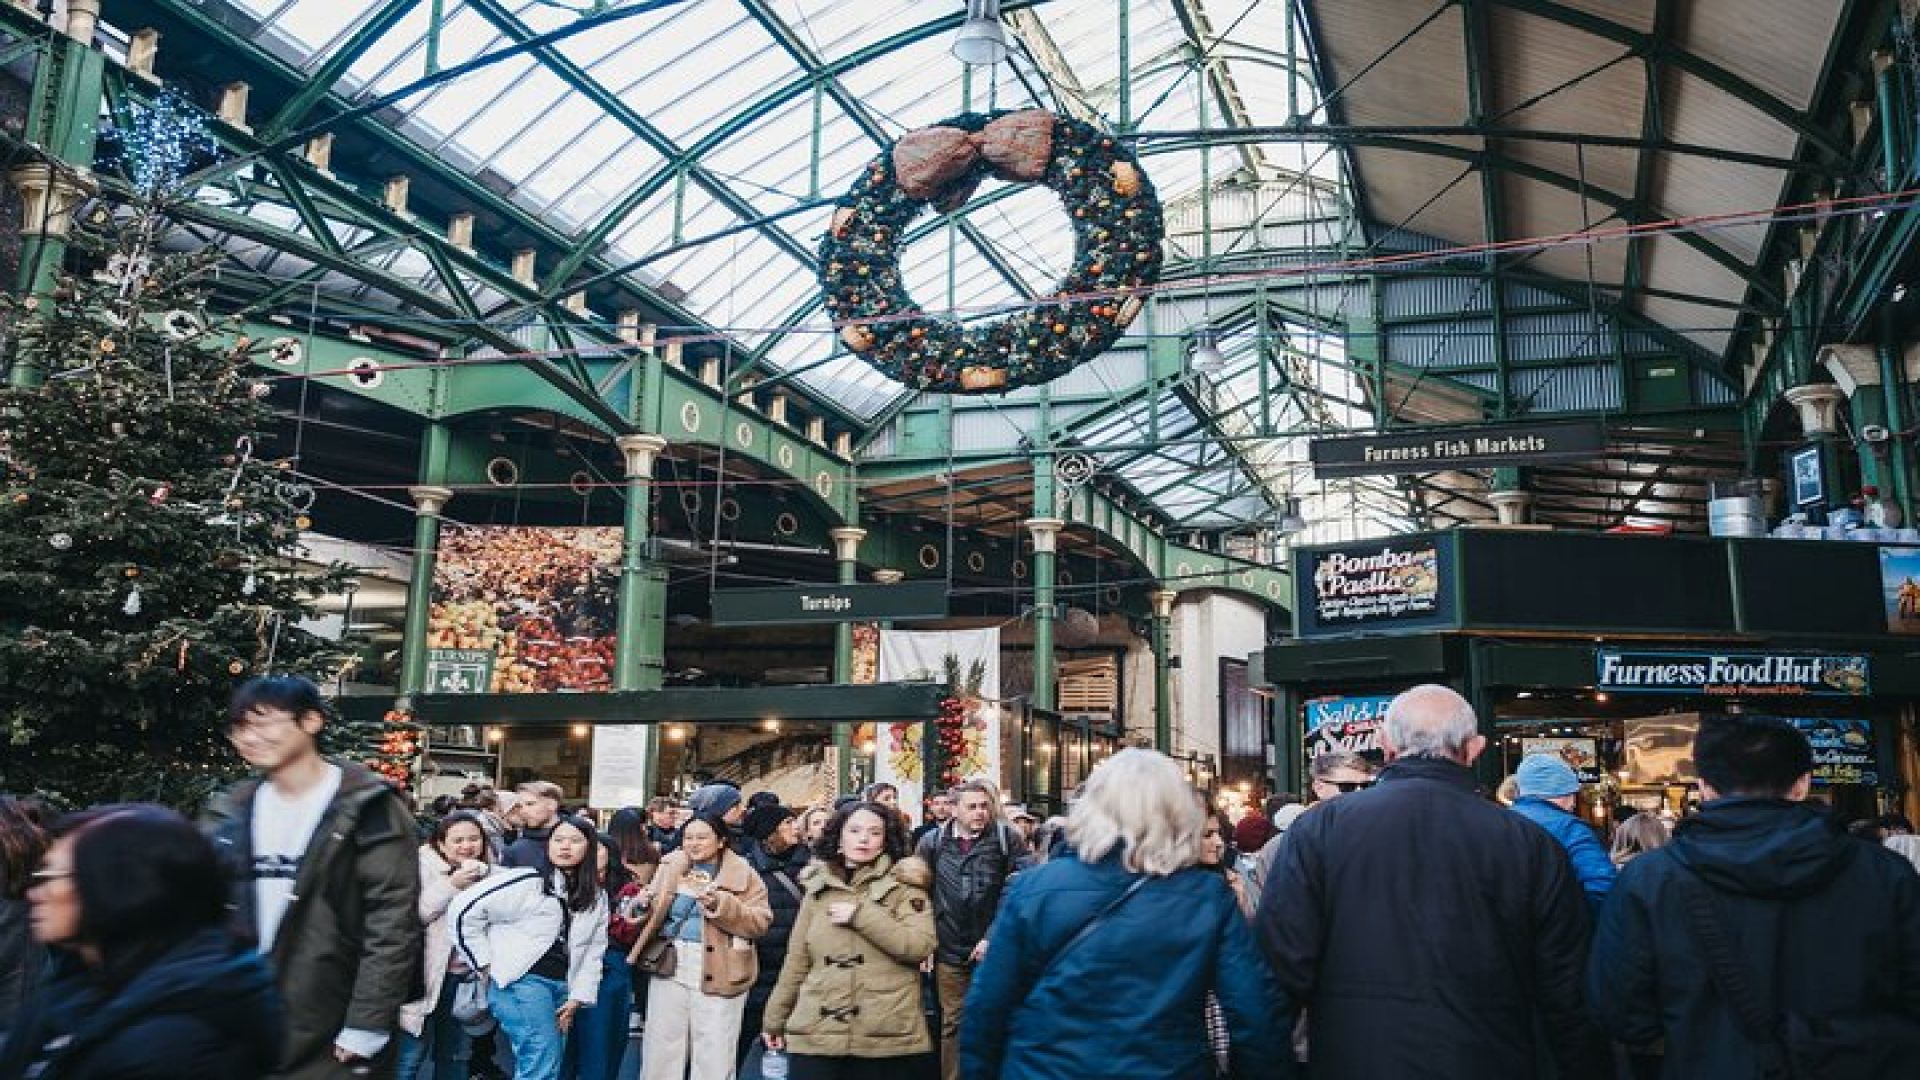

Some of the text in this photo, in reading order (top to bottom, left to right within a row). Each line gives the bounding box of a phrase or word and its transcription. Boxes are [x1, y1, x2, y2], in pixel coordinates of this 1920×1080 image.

[1364, 435, 1545, 462] Furness Fish Markets
[1328, 548, 1412, 572] Bomba
[1327, 571, 1401, 595] Paella
[800, 594, 852, 612] Turnips
[1601, 656, 1822, 684] Furness Food Hut
